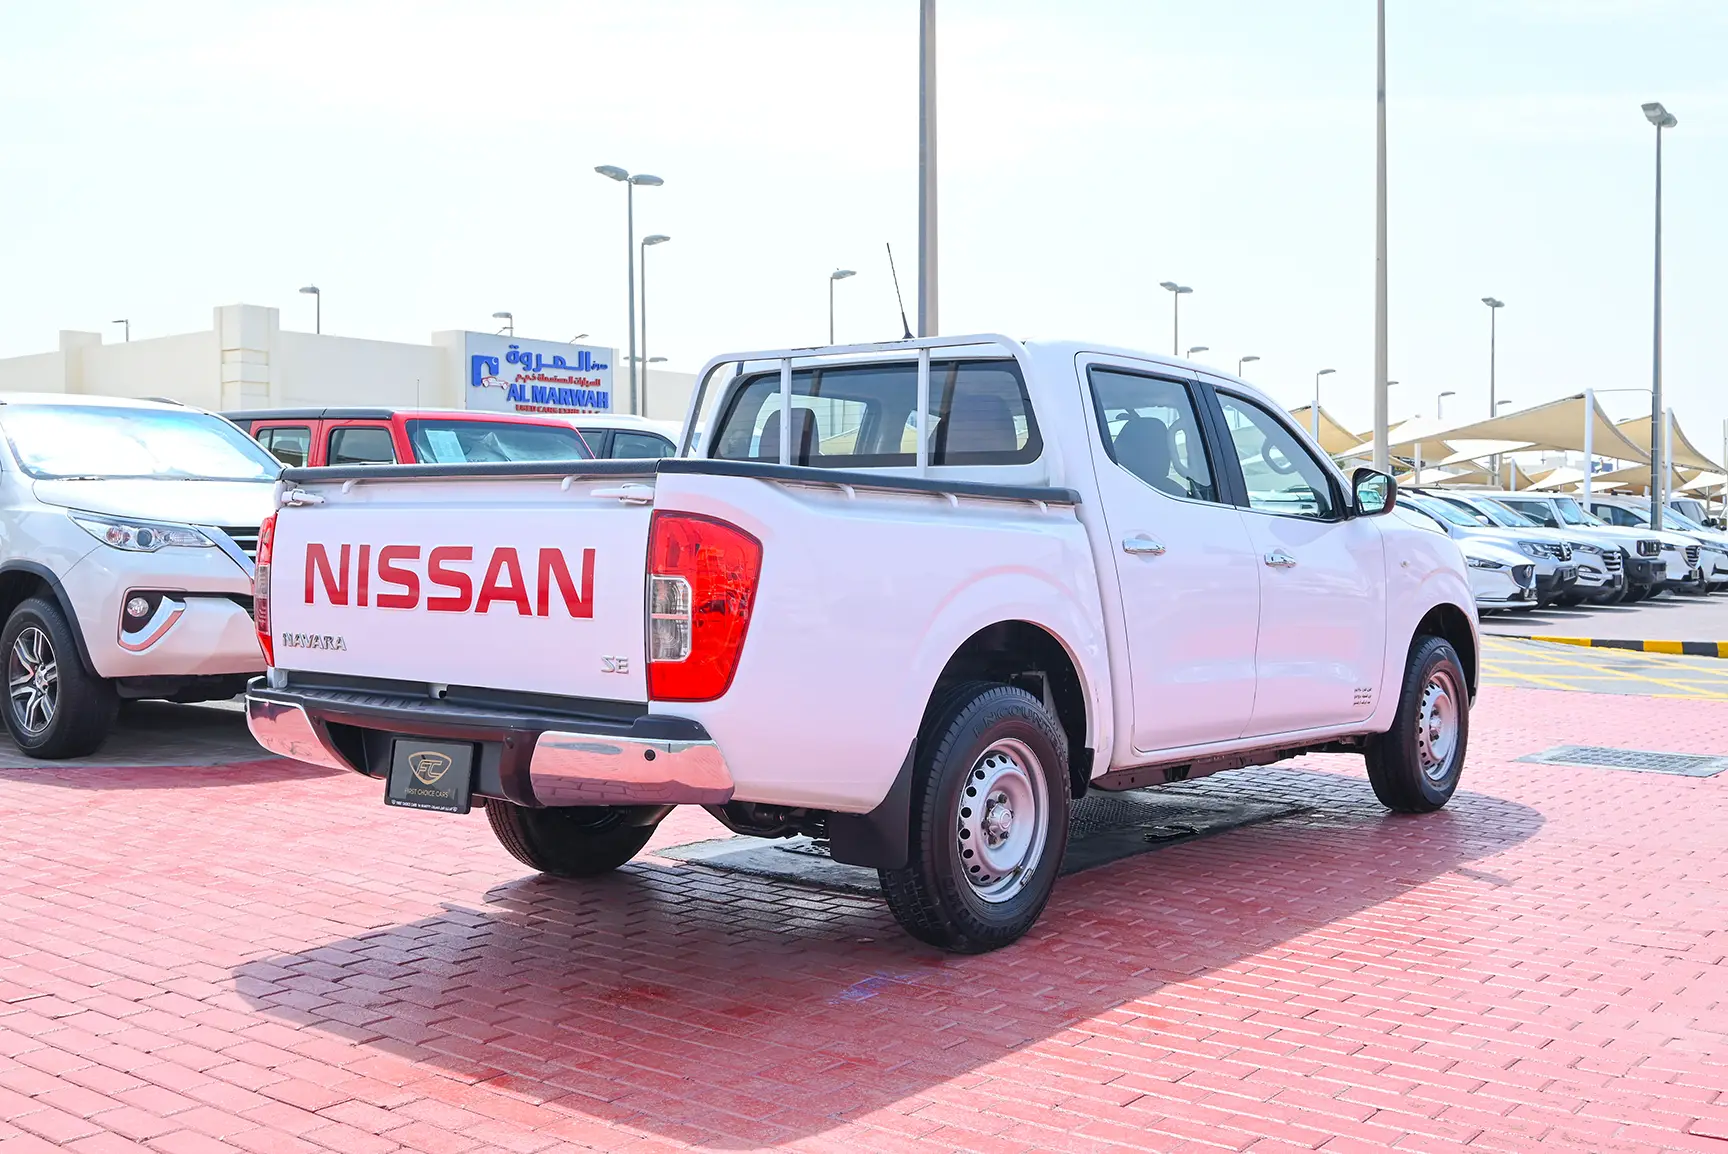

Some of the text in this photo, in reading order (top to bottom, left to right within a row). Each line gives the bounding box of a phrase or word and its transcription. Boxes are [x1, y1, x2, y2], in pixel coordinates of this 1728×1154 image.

[506, 345, 590, 371] المروة
[507, 383, 609, 409] AL MARWAH
[304, 542, 596, 619] NISSAN
[282, 632, 347, 651] NAVARA
[600, 655, 629, 674] SE
[417, 789, 435, 797] CHOICE
[435, 790, 449, 798] CARS
